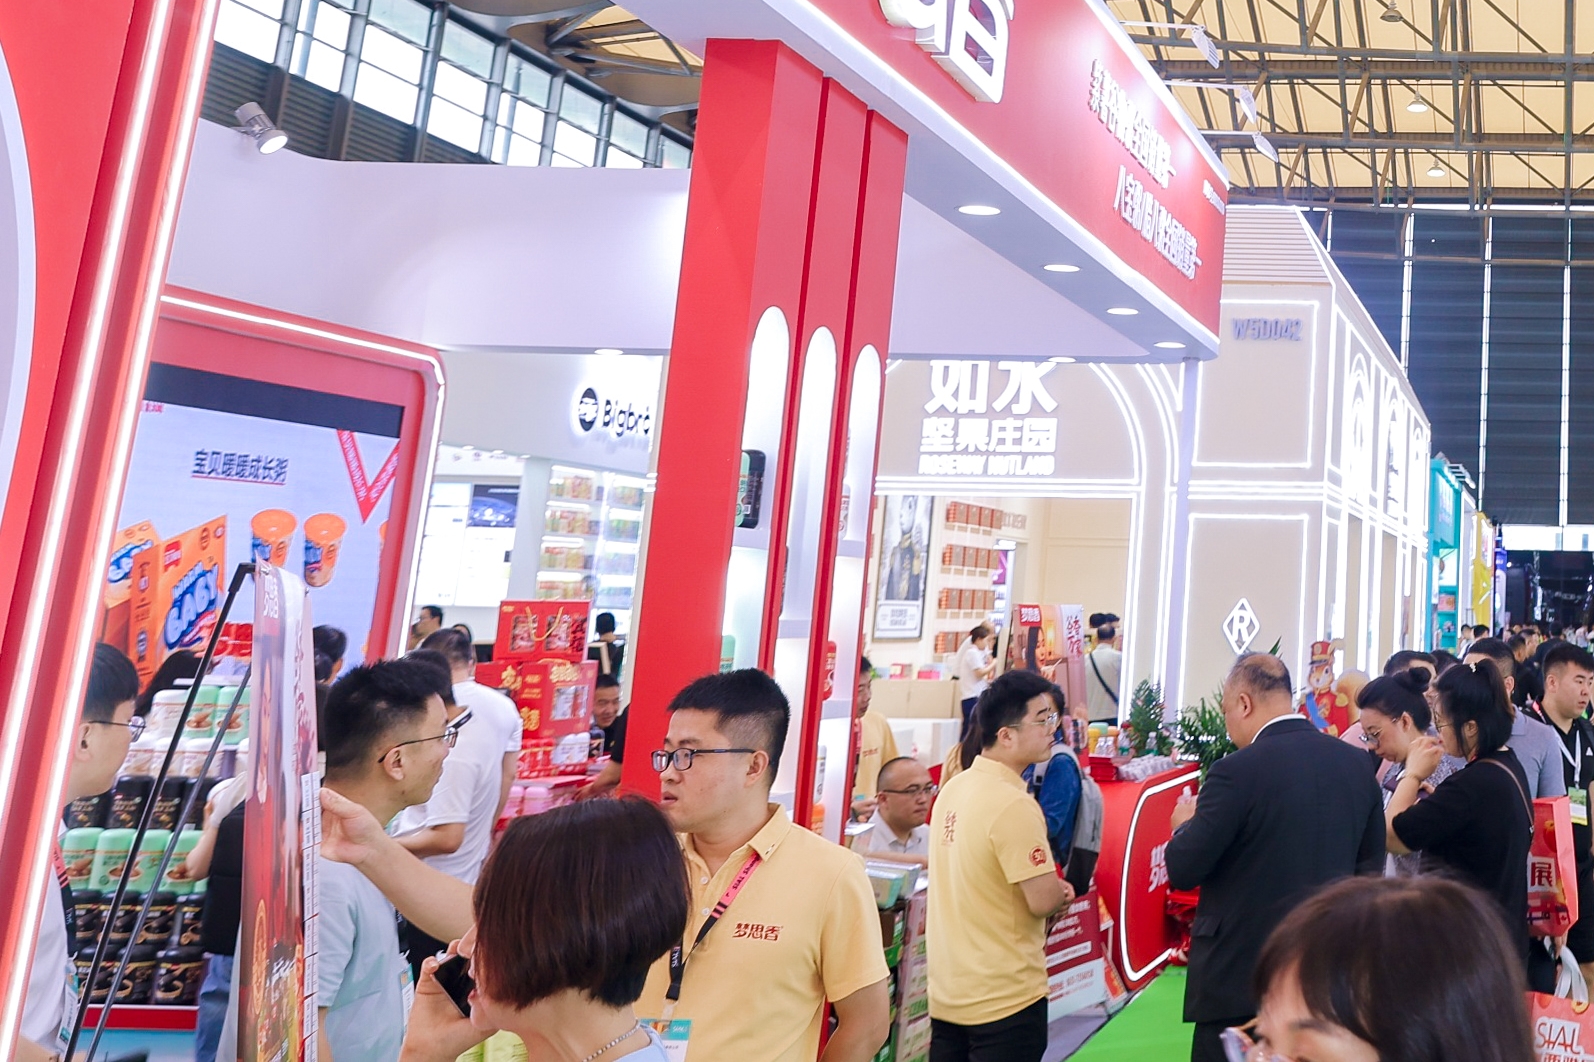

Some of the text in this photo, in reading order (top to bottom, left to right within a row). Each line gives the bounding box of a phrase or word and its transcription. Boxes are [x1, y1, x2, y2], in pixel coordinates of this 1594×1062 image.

[923, 359, 1059, 415] 如水
[919, 416, 1058, 453] 坚果庄园
[732, 922, 781, 942] 梦思香
[1537, 1021, 1581, 1055] SIAL
